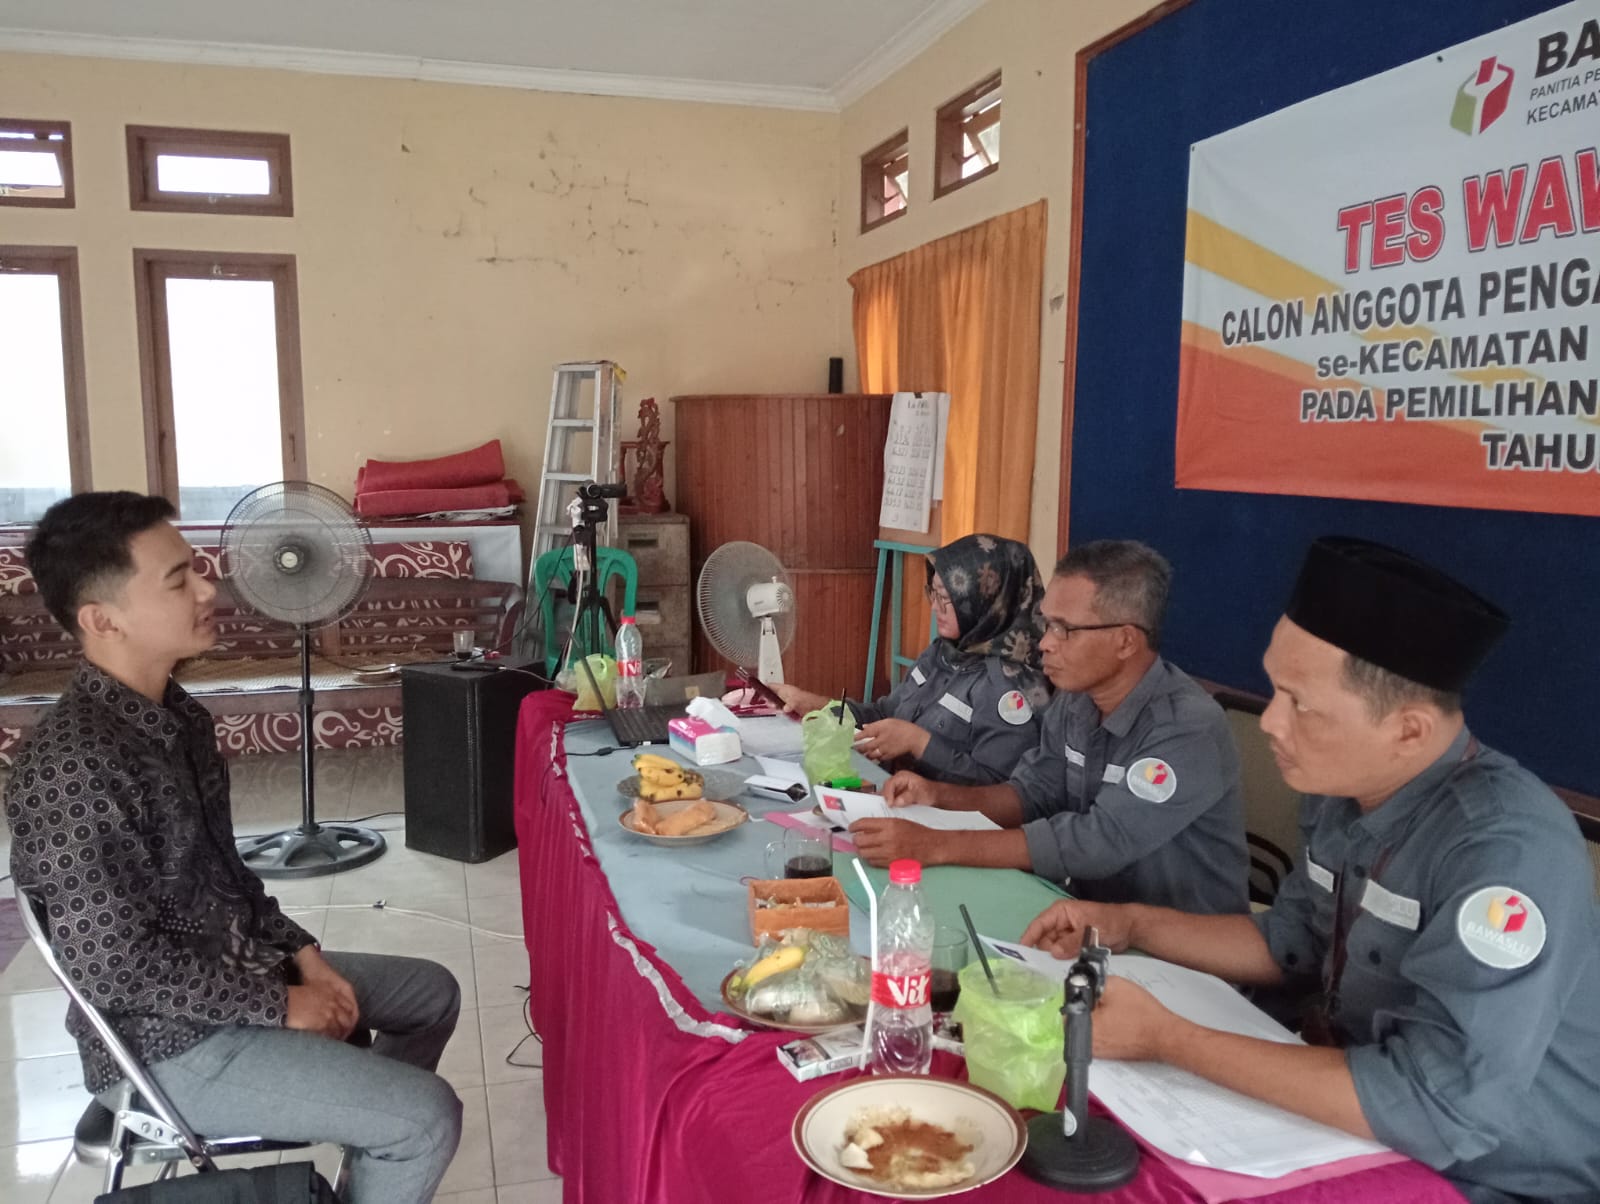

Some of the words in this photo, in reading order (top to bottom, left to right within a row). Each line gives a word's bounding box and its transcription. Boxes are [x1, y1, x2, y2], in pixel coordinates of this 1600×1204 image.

[1530, 75, 1581, 100] PANITIA
[1527, 90, 1600, 125] KECAMA
[1337, 185, 1446, 274] TES
[1222, 300, 1304, 346] CALON
[1311, 276, 1466, 336] ANGGOTA
[1317, 325, 1588, 378] se-KECAMATAN
[1301, 389, 1375, 420] PADA
[1386, 379, 1598, 419] PEMILIHAN
[1482, 433, 1600, 470] TAHU
[887, 975, 930, 1006] Vit
